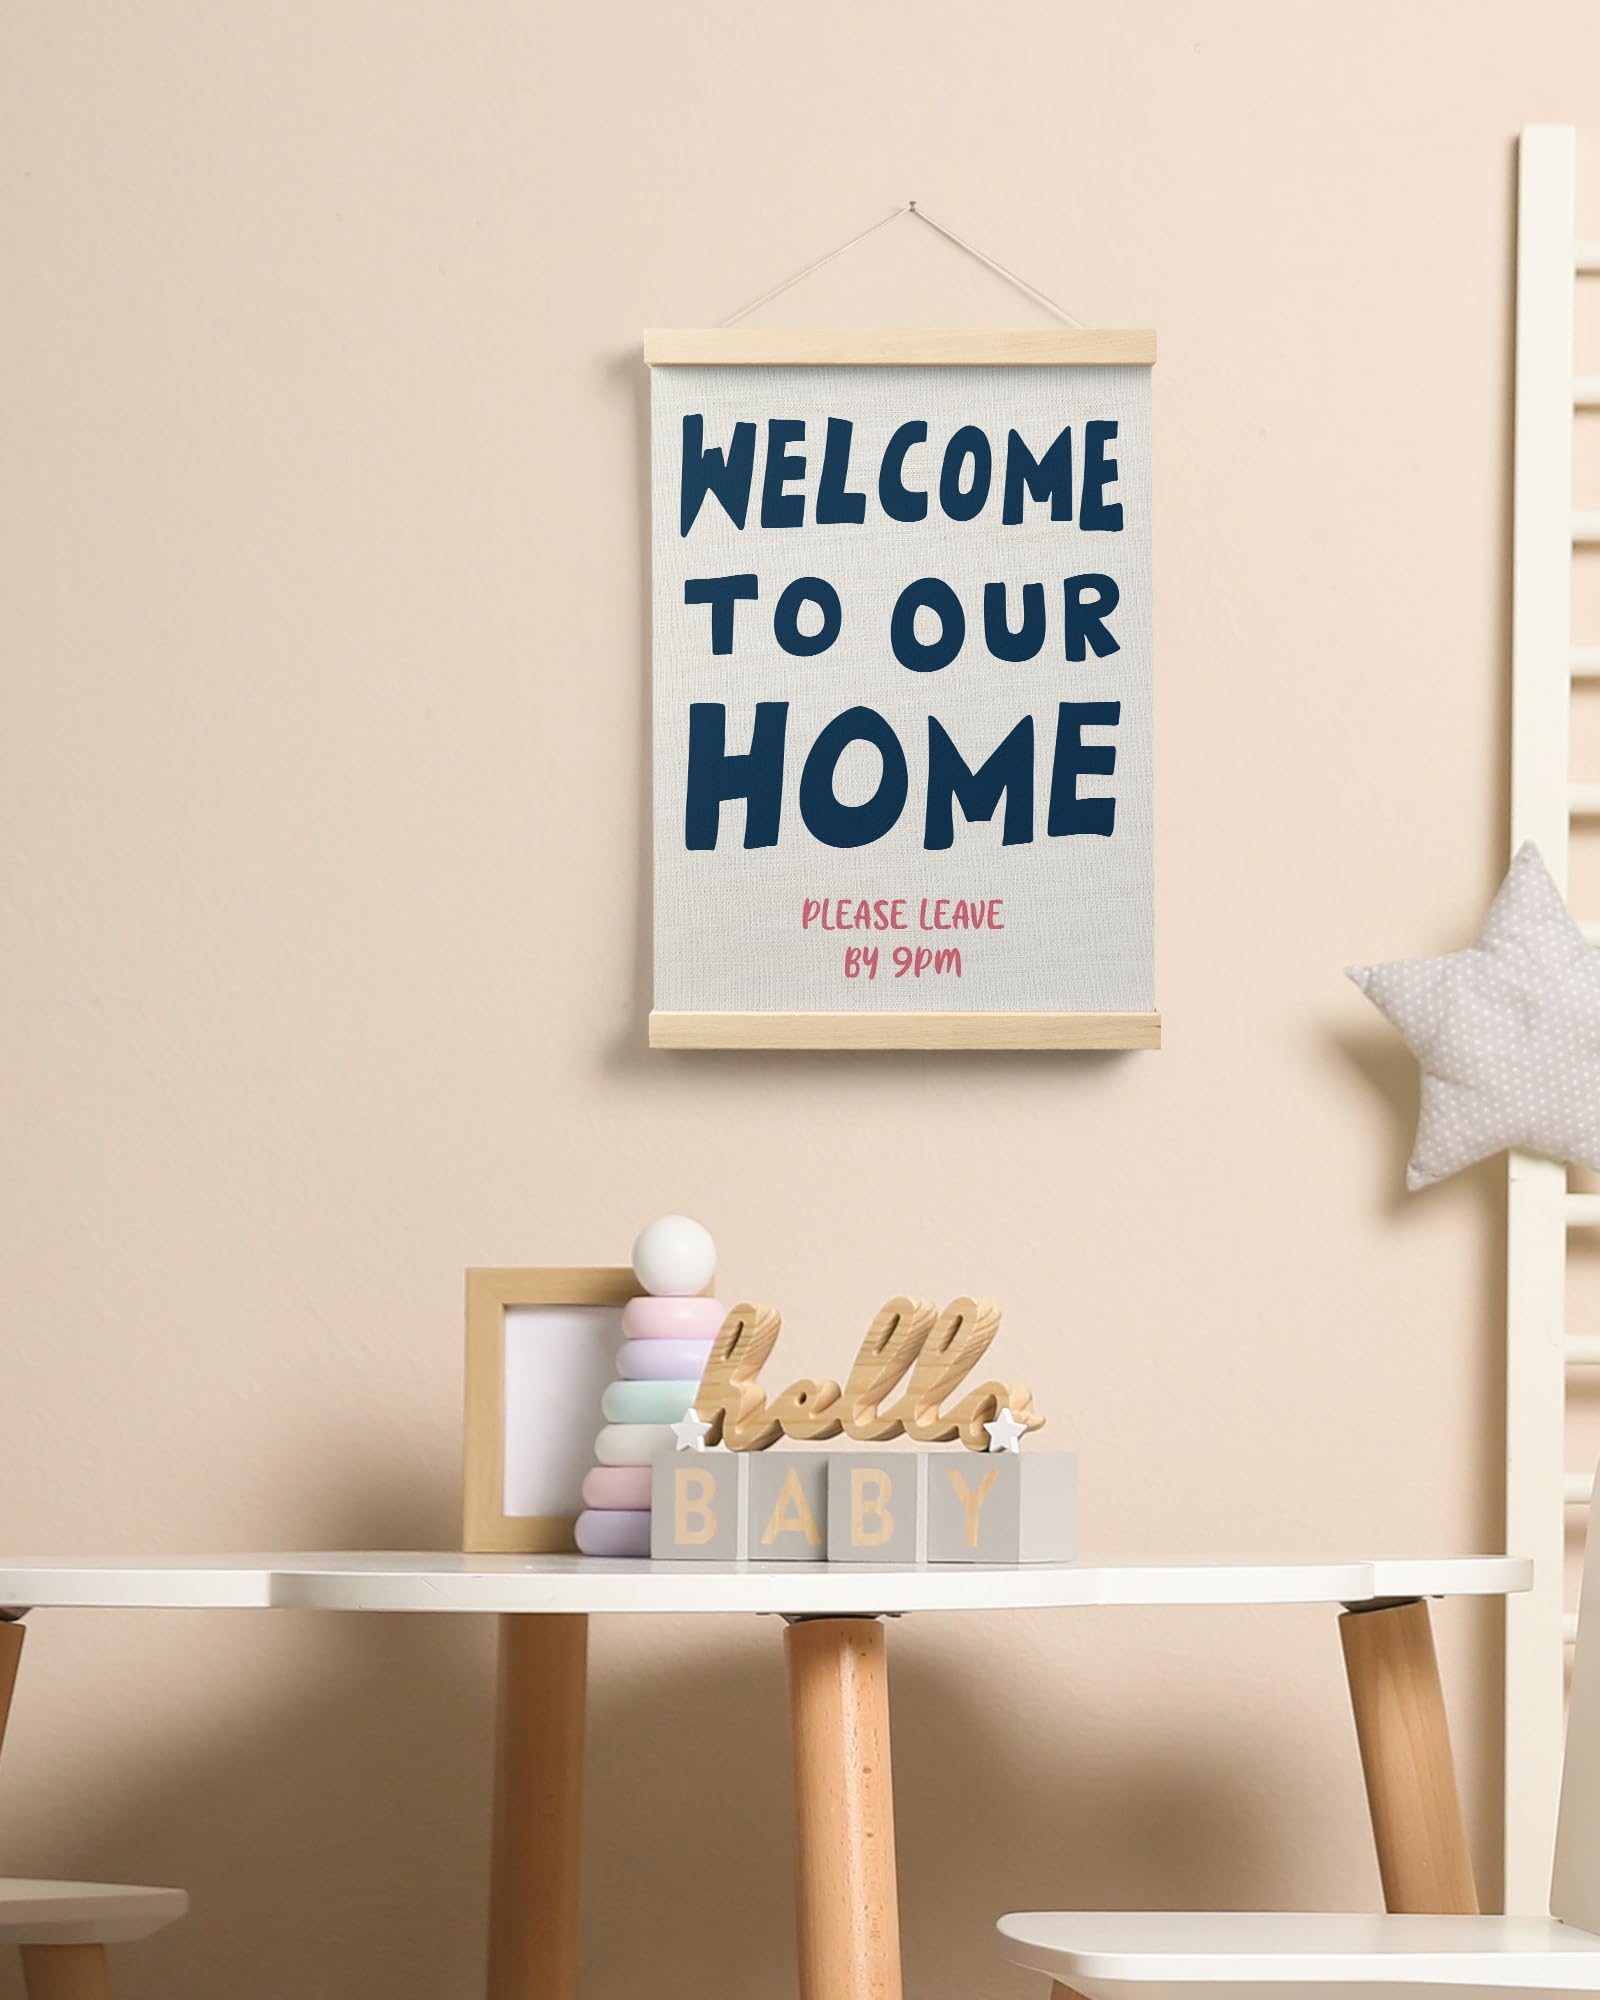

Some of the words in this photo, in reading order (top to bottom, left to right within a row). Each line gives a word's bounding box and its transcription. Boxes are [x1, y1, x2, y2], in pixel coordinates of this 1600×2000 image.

[680, 413, 1124, 538] WELCOME
[684, 574, 842, 657] TO
[890, 573, 1121, 673] OUR
[685, 700, 1121, 851] HOME
[802, 897, 909, 932] PLEASE
[919, 897, 1006, 932] LEAVE
[843, 945, 879, 981] BY
[674, 1468, 998, 1547] BABY
